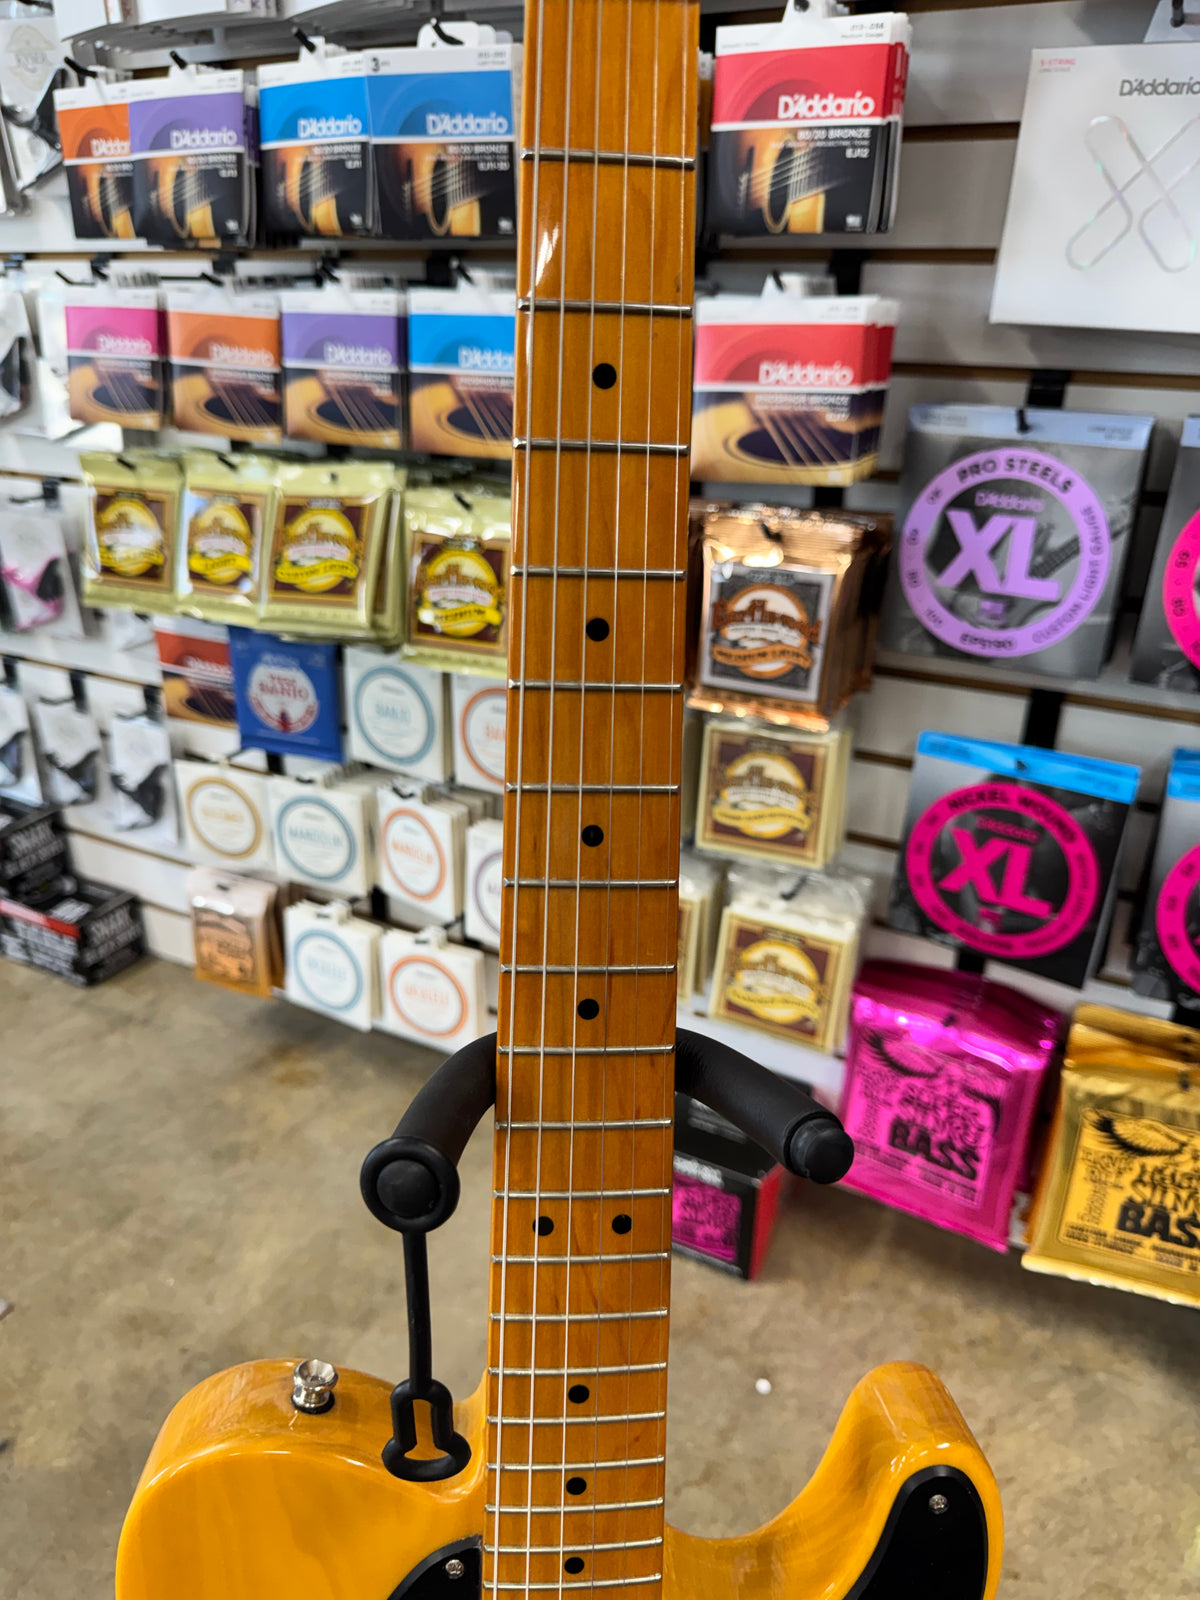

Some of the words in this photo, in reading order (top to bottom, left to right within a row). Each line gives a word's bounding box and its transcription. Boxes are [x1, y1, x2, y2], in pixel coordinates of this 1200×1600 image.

[372, 57, 381, 73] 3
[1119, 76, 1200, 97] D'Addario
[778, 90, 875, 119] D'Addario
[297, 114, 362, 138] D'Addario
[426, 111, 508, 136] D'Addario
[828, 127, 872, 139] BRONZE
[90, 138, 131, 157] D'Addar
[170, 125, 238, 149] D'Addario
[324, 342, 392, 366] D'Addario
[458, 344, 515, 369] D'Addar
[758, 359, 854, 386] D'Addario
[956, 458, 997, 483] PRO
[1005, 458, 1073, 494] STEELS
[935, 508, 1060, 601] XL
[937, 825, 1053, 919] XL
[888, 1114, 980, 1181] BASS
[1116, 1197, 1200, 1249] BAS
